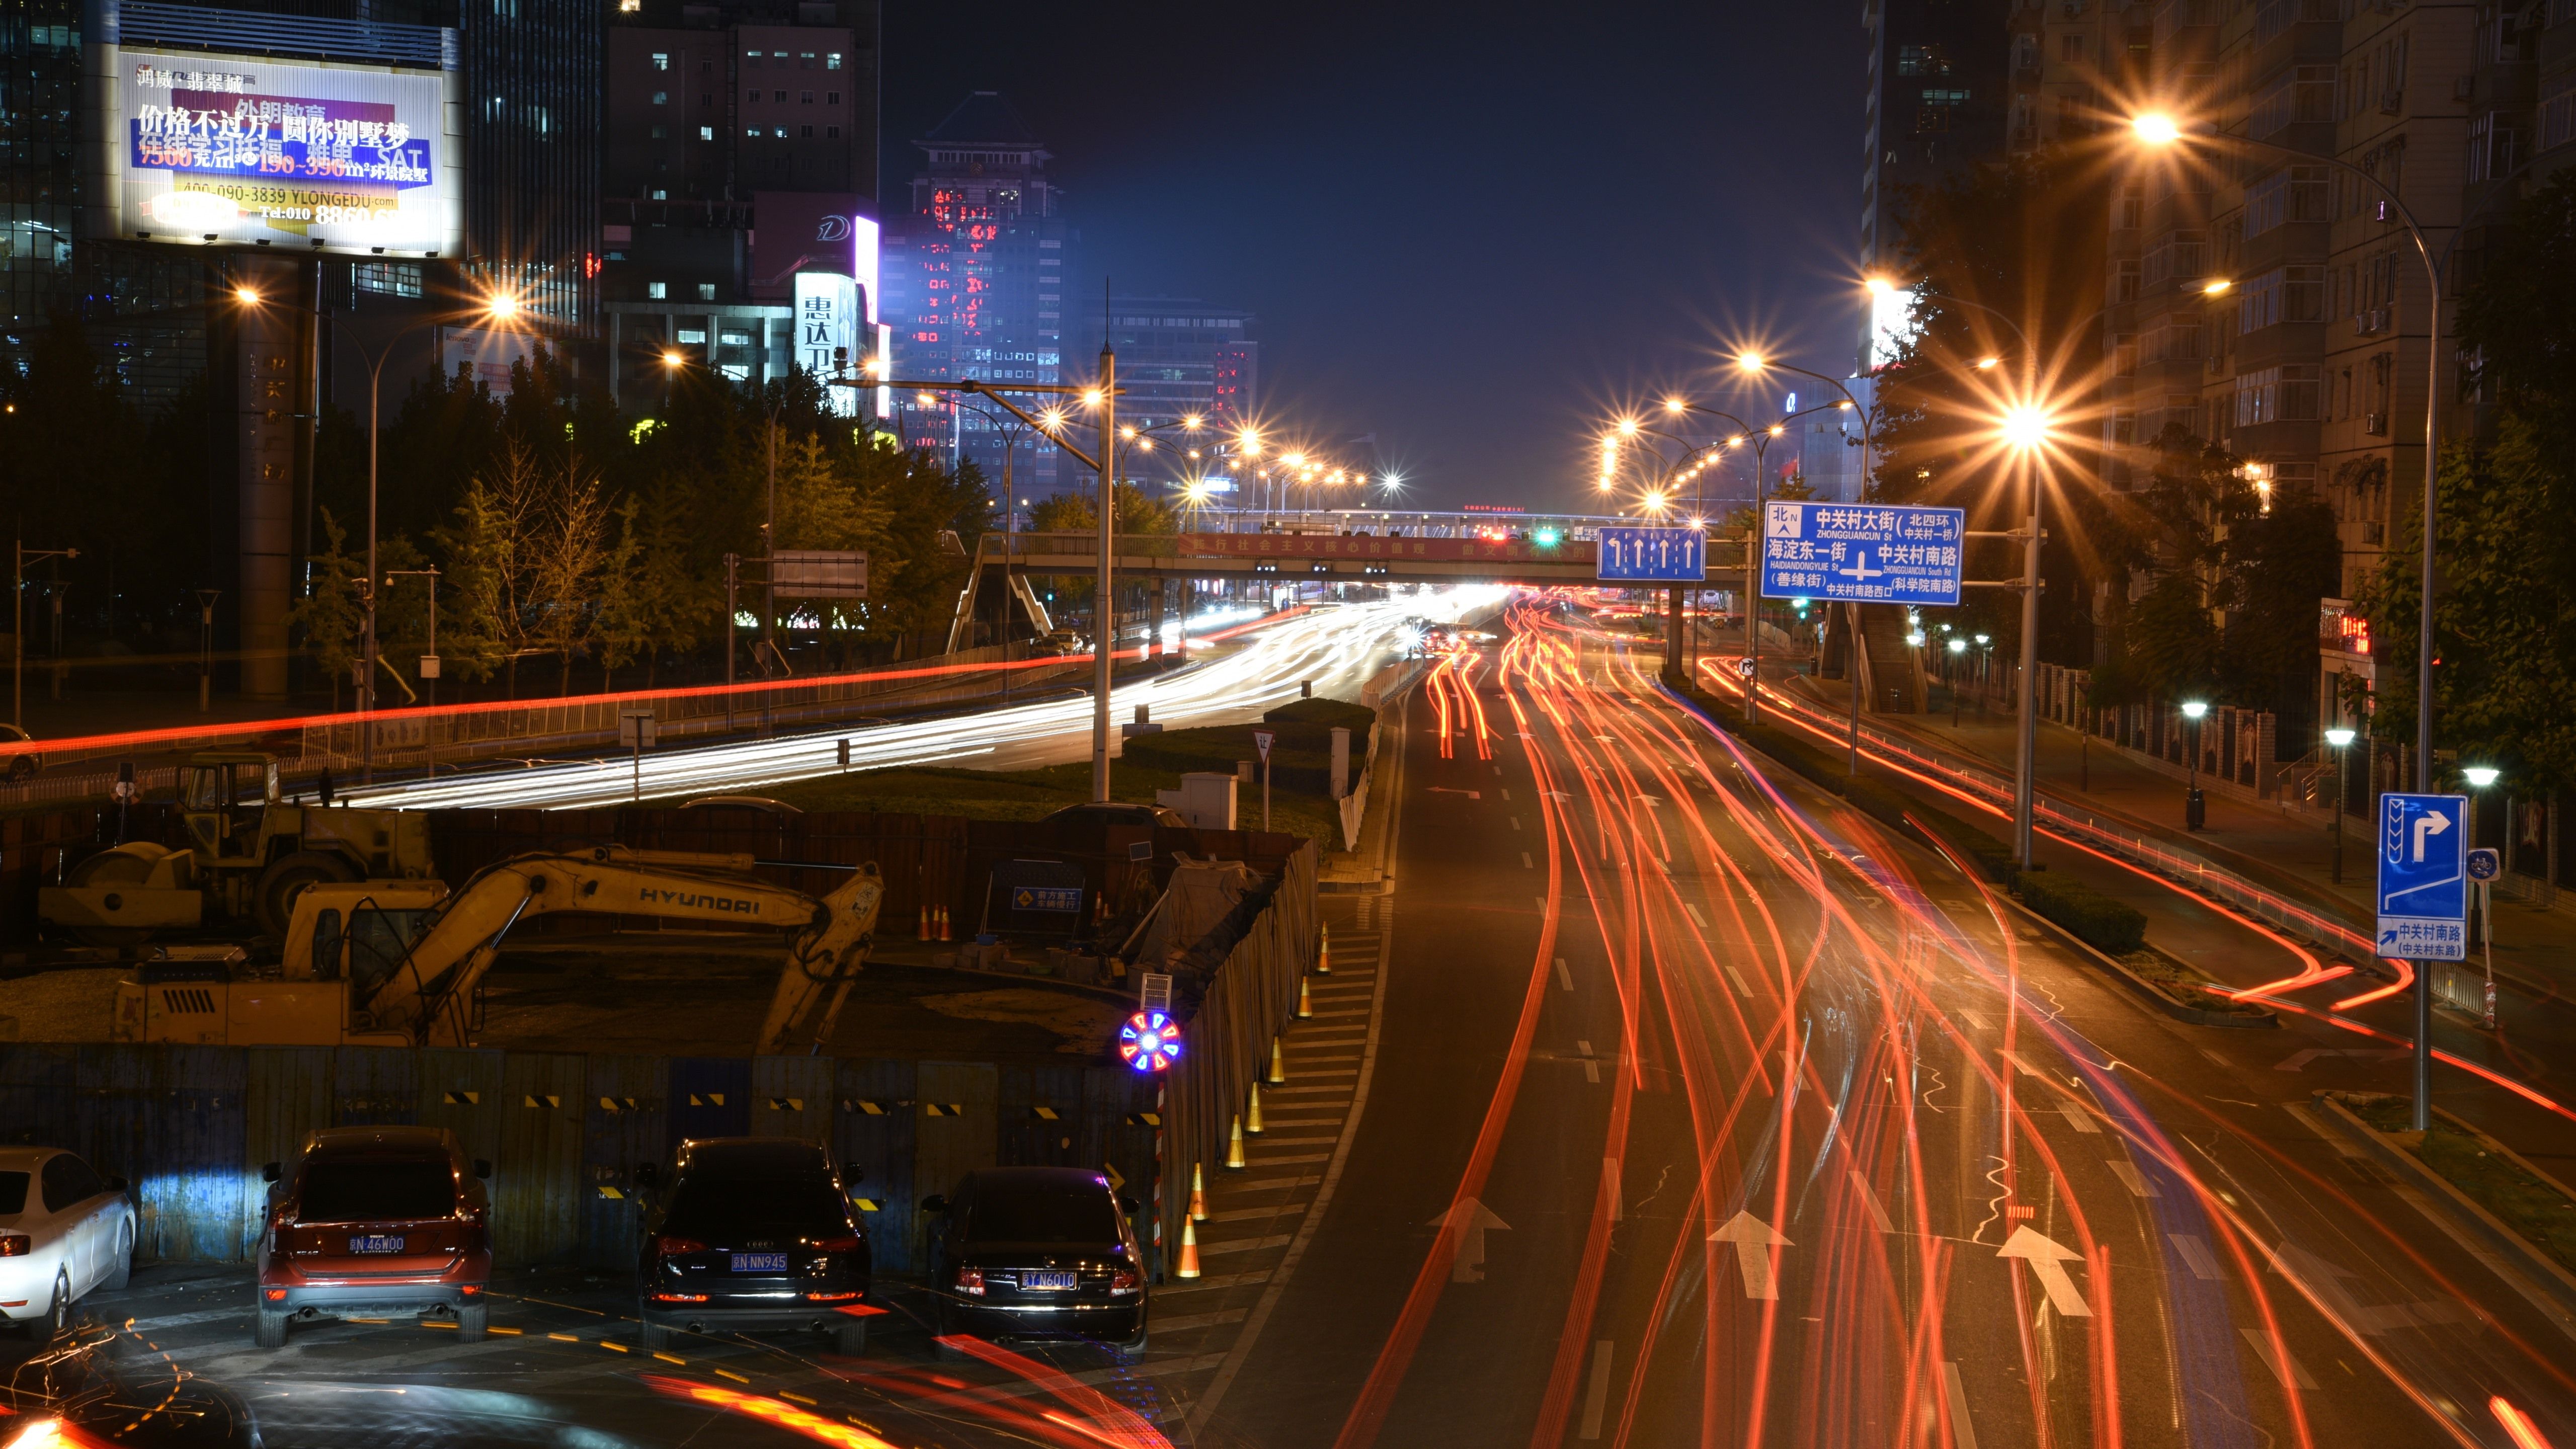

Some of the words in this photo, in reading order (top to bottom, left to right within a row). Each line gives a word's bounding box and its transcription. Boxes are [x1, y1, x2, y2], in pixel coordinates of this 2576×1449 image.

[138, 104, 270, 140] 价格不过万
[282, 115, 410, 150] 圆你别墅梦
[184, 182, 286, 204] 400-090-3839
[259, 205, 311, 220] Tel:010
[446, 333, 469, 343] lenovo
[1774, 507, 1788, 522] 北
[1791, 513, 1797, 522] N
[1816, 508, 1895, 531] 中关村大街
[1909, 514, 1949, 526] 北四环
[1817, 530, 1880, 541] ZHONGGUANCUN
[1884, 533, 1892, 541] St
[1904, 528, 1953, 541] 中关村一桥
[1192, 538, 1426, 555] 践行社会主义核心价值观
[1768, 538, 1846, 561] 海淀东一街
[1878, 543, 1957, 566] 中关村南路
[1770, 560, 1828, 571] HAIDIANDONGYIJIE
[1832, 563, 1838, 571] St
[1883, 566, 1926, 576] ZHONGGUANCUN
[1928, 568, 1942, 576] South
[1945, 568, 1951, 576] Rd
[1827, 583, 1892, 598] 中关村南路西口
[1259, 735, 1267, 749] 让
[639, 888, 760, 915] HYUNDAI
[1037, 891, 1076, 900] 前方施工
[1037, 900, 1076, 909] 车辆慢行
[2399, 922, 2460, 942] 中关村南路
[2398, 944, 2460, 956] (中关村东路)
